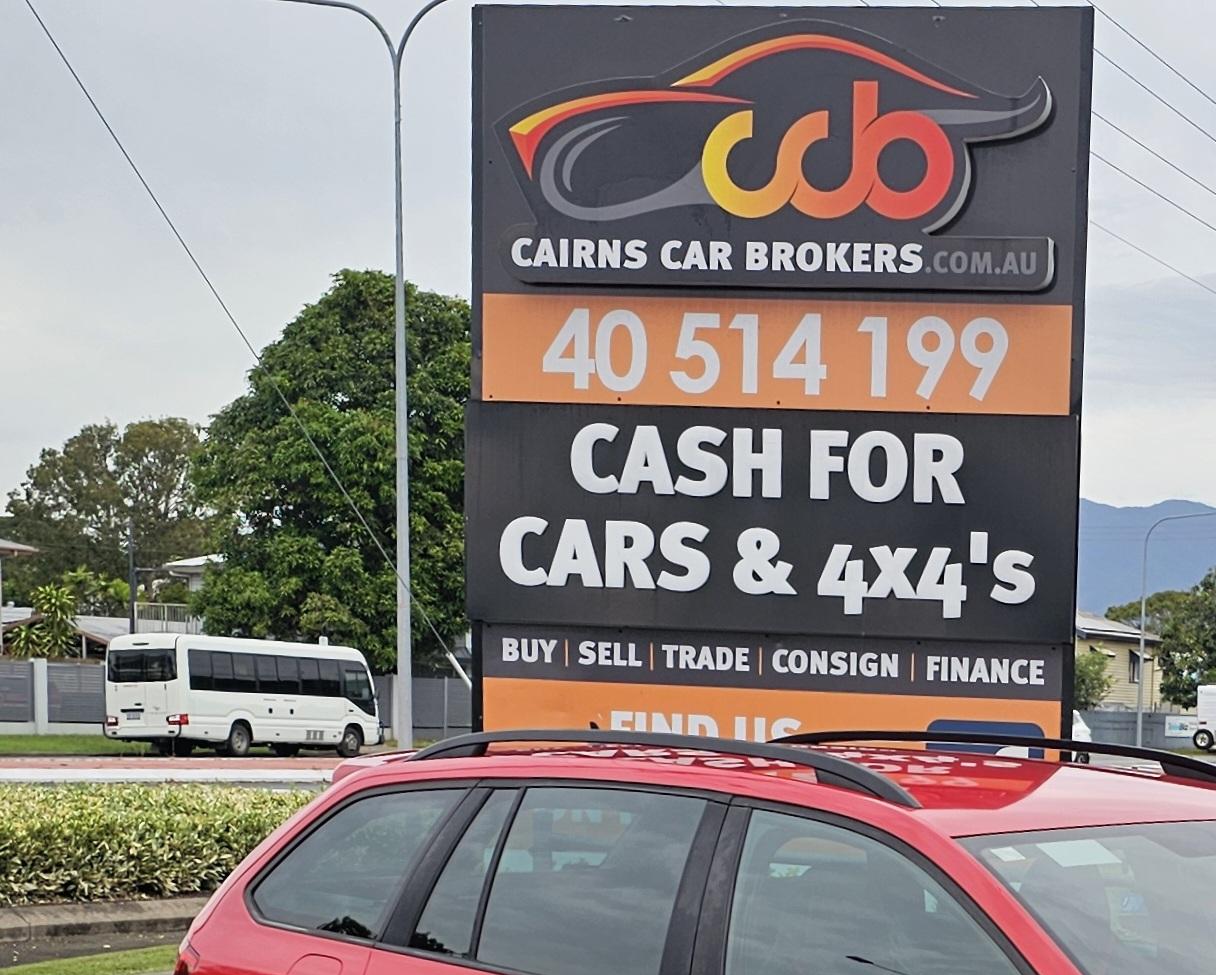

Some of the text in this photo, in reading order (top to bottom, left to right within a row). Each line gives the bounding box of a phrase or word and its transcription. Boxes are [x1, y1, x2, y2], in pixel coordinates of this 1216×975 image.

[511, 238, 648, 269] CAIRNS
[660, 240, 733, 271] CAR
[543, 308, 1009, 402] 40 514 199
[570, 422, 966, 505] CASH FOR
[499, 516, 711, 592] CARS
[732, 527, 798, 596] &
[502, 637, 1045, 686] BUY SELL TRADE CONSIGN FINANCE
